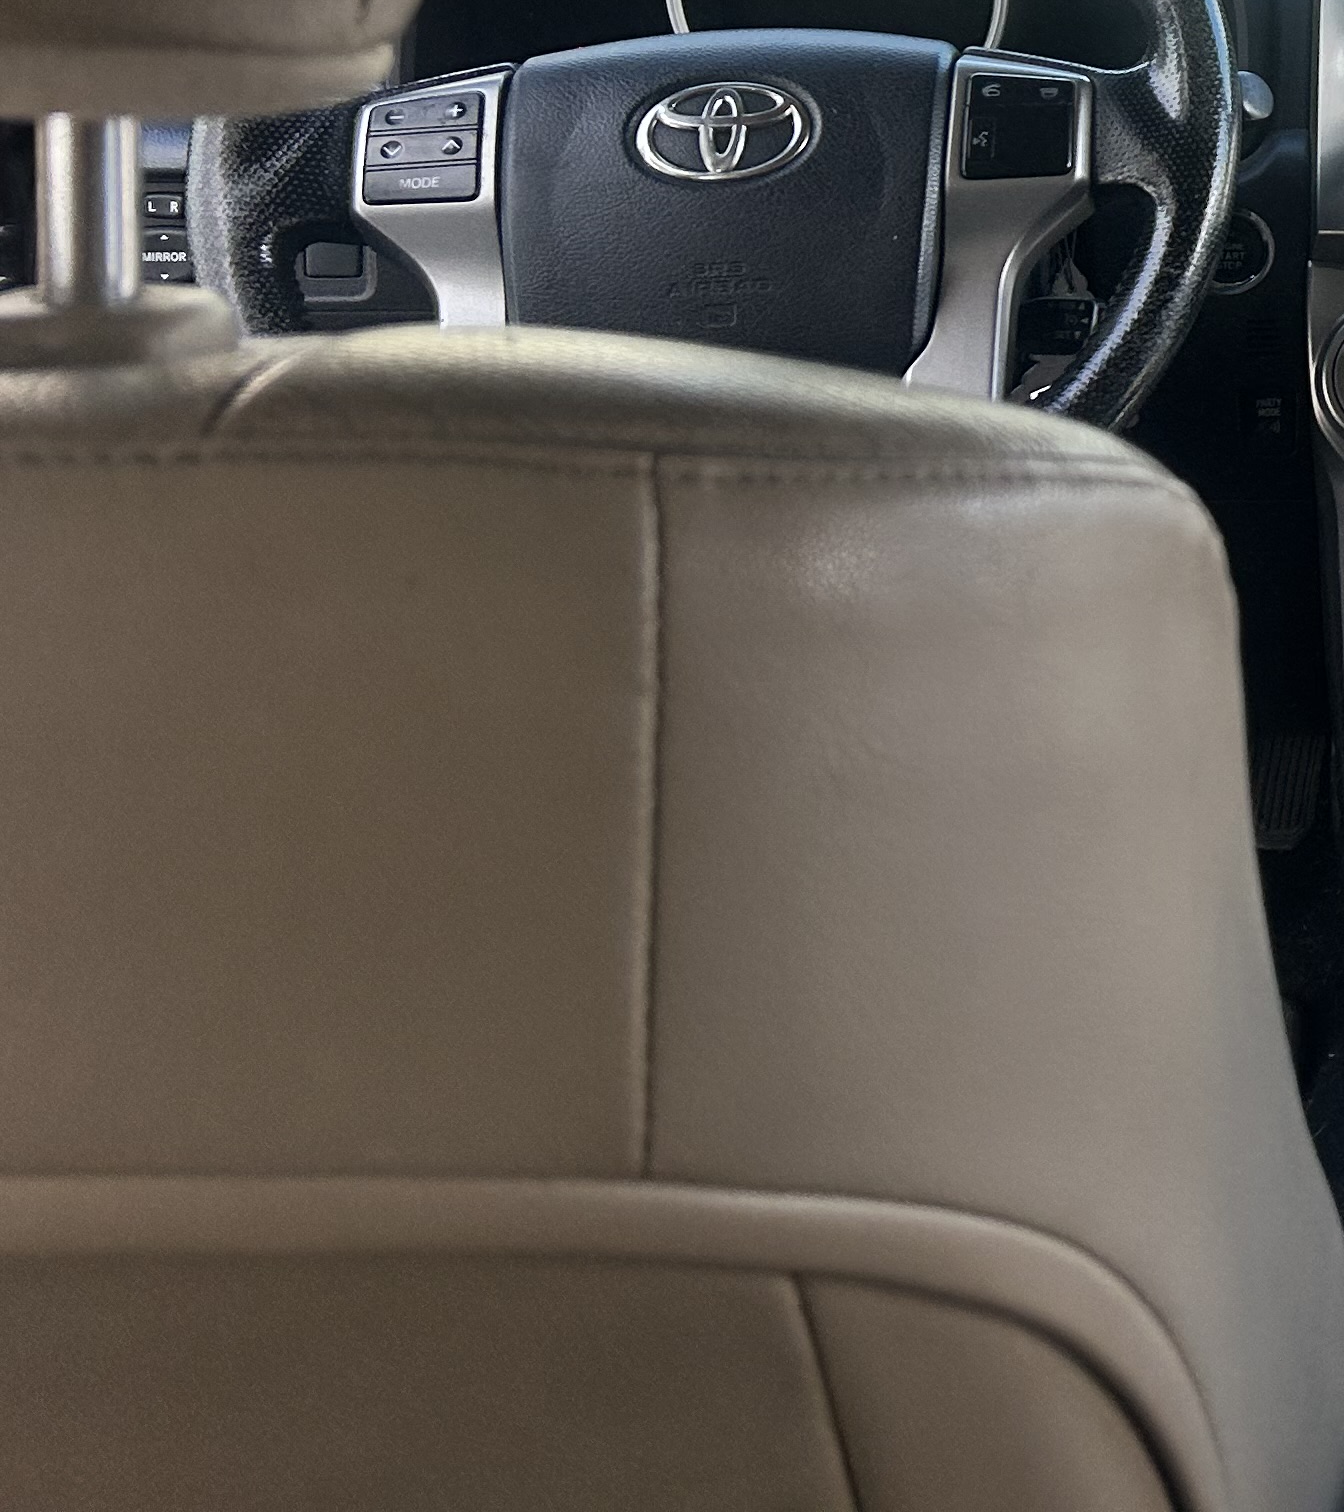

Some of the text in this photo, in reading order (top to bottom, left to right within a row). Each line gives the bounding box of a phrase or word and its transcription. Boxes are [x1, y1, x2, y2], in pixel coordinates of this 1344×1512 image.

[399, 175, 440, 189] MODE
[147, 201, 157, 212] L
[169, 201, 179, 212] R
[141, 251, 187, 262] MIRROR
